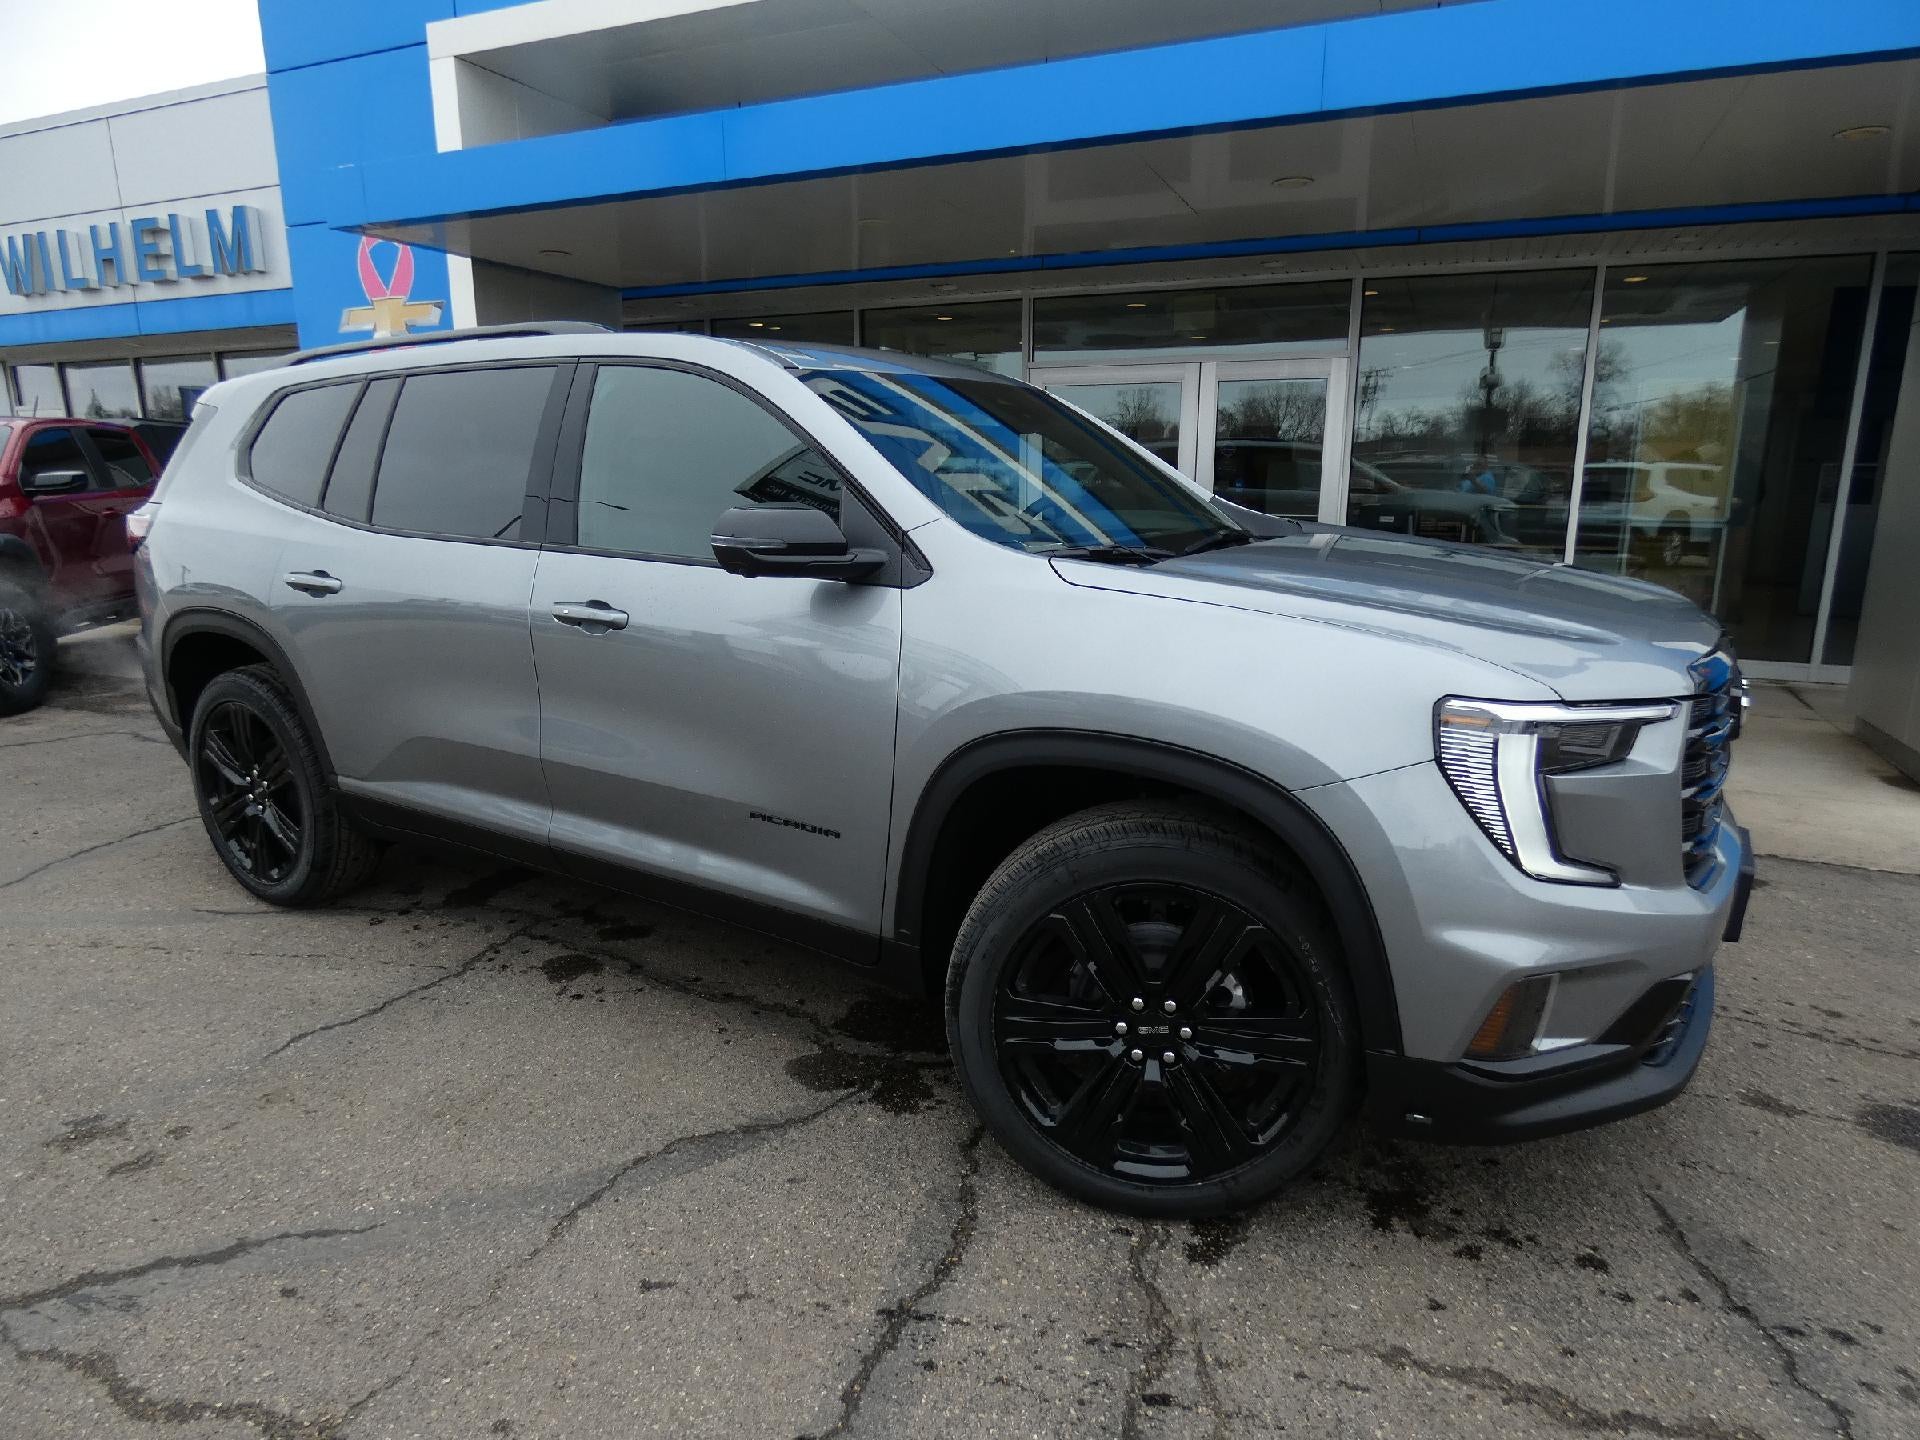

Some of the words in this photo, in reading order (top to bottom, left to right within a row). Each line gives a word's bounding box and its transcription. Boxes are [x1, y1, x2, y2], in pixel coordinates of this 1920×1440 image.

[0, 205, 263, 296] WILHELM
[749, 811, 841, 839] ACADIA
[1138, 1025, 1170, 1035] GMC
